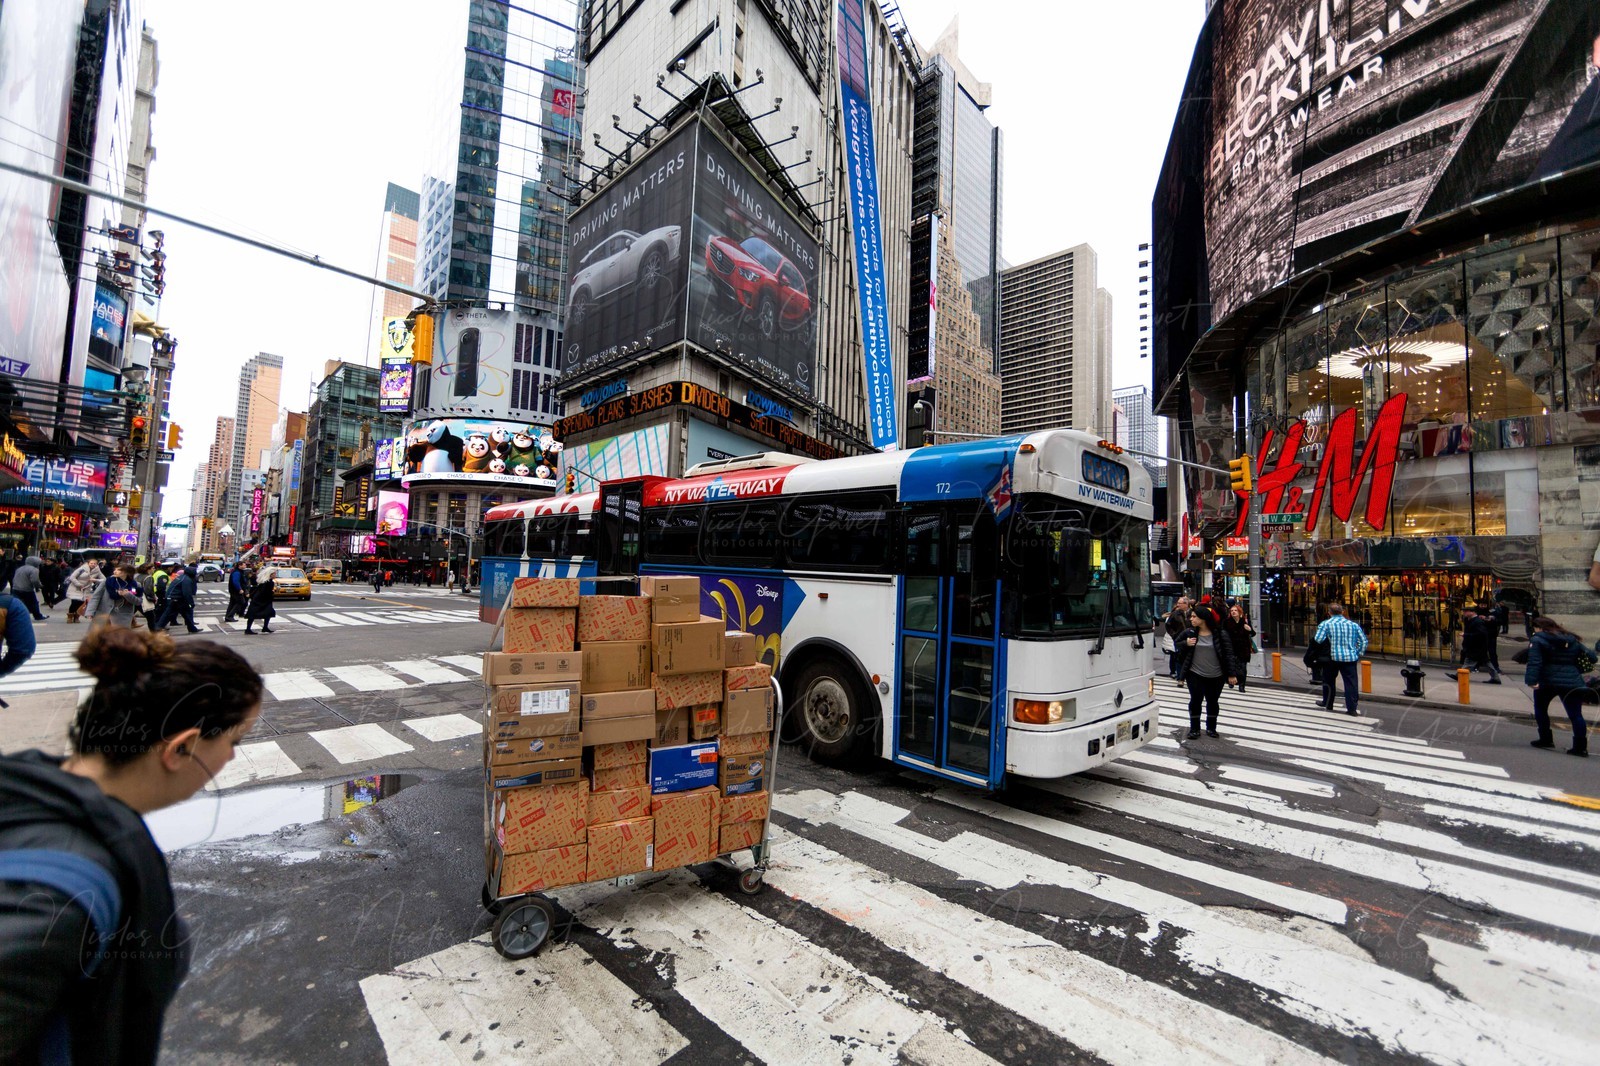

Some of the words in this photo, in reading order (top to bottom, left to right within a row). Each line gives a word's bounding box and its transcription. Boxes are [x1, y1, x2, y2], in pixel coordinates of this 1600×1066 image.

[1232, 56, 1383, 180] BODYWEAR
[573, 201, 619, 247] DRIVING
[622, 153, 685, 212] MATTERS
[706, 153, 763, 220] DRIVING
[767, 214, 815, 271] MATTERS
[850, 98, 884, 439] Walgreens.com/healthychoices
[868, 195, 879, 272] Rewards
[877, 305, 887, 368] Healthy
[882, 373, 892, 438] Choices
[630, 383, 673, 415] SLASHES
[681, 382, 731, 418] DIVIDEND
[750, 411, 776, 438] SHELL
[779, 424, 803, 450] PROFIT
[26, 467, 89, 488] BLUE
[1084, 454, 1127, 491] FERRY
[1235, 393, 1408, 538] H&M
[665, 489, 686, 502] NY
[687, 477, 782, 500] WATERWAY
[936, 482, 951, 494] 172
[1078, 484, 1092, 497] NY
[1092, 488, 1135, 510] WATERWAY
[252, 489, 262, 532] REGAL
[1262, 524, 1292, 532] Lincoln
[755, 583, 779, 602] Disney
[496, 779, 509, 787] 1500
[727, 784, 739, 792] 1500
